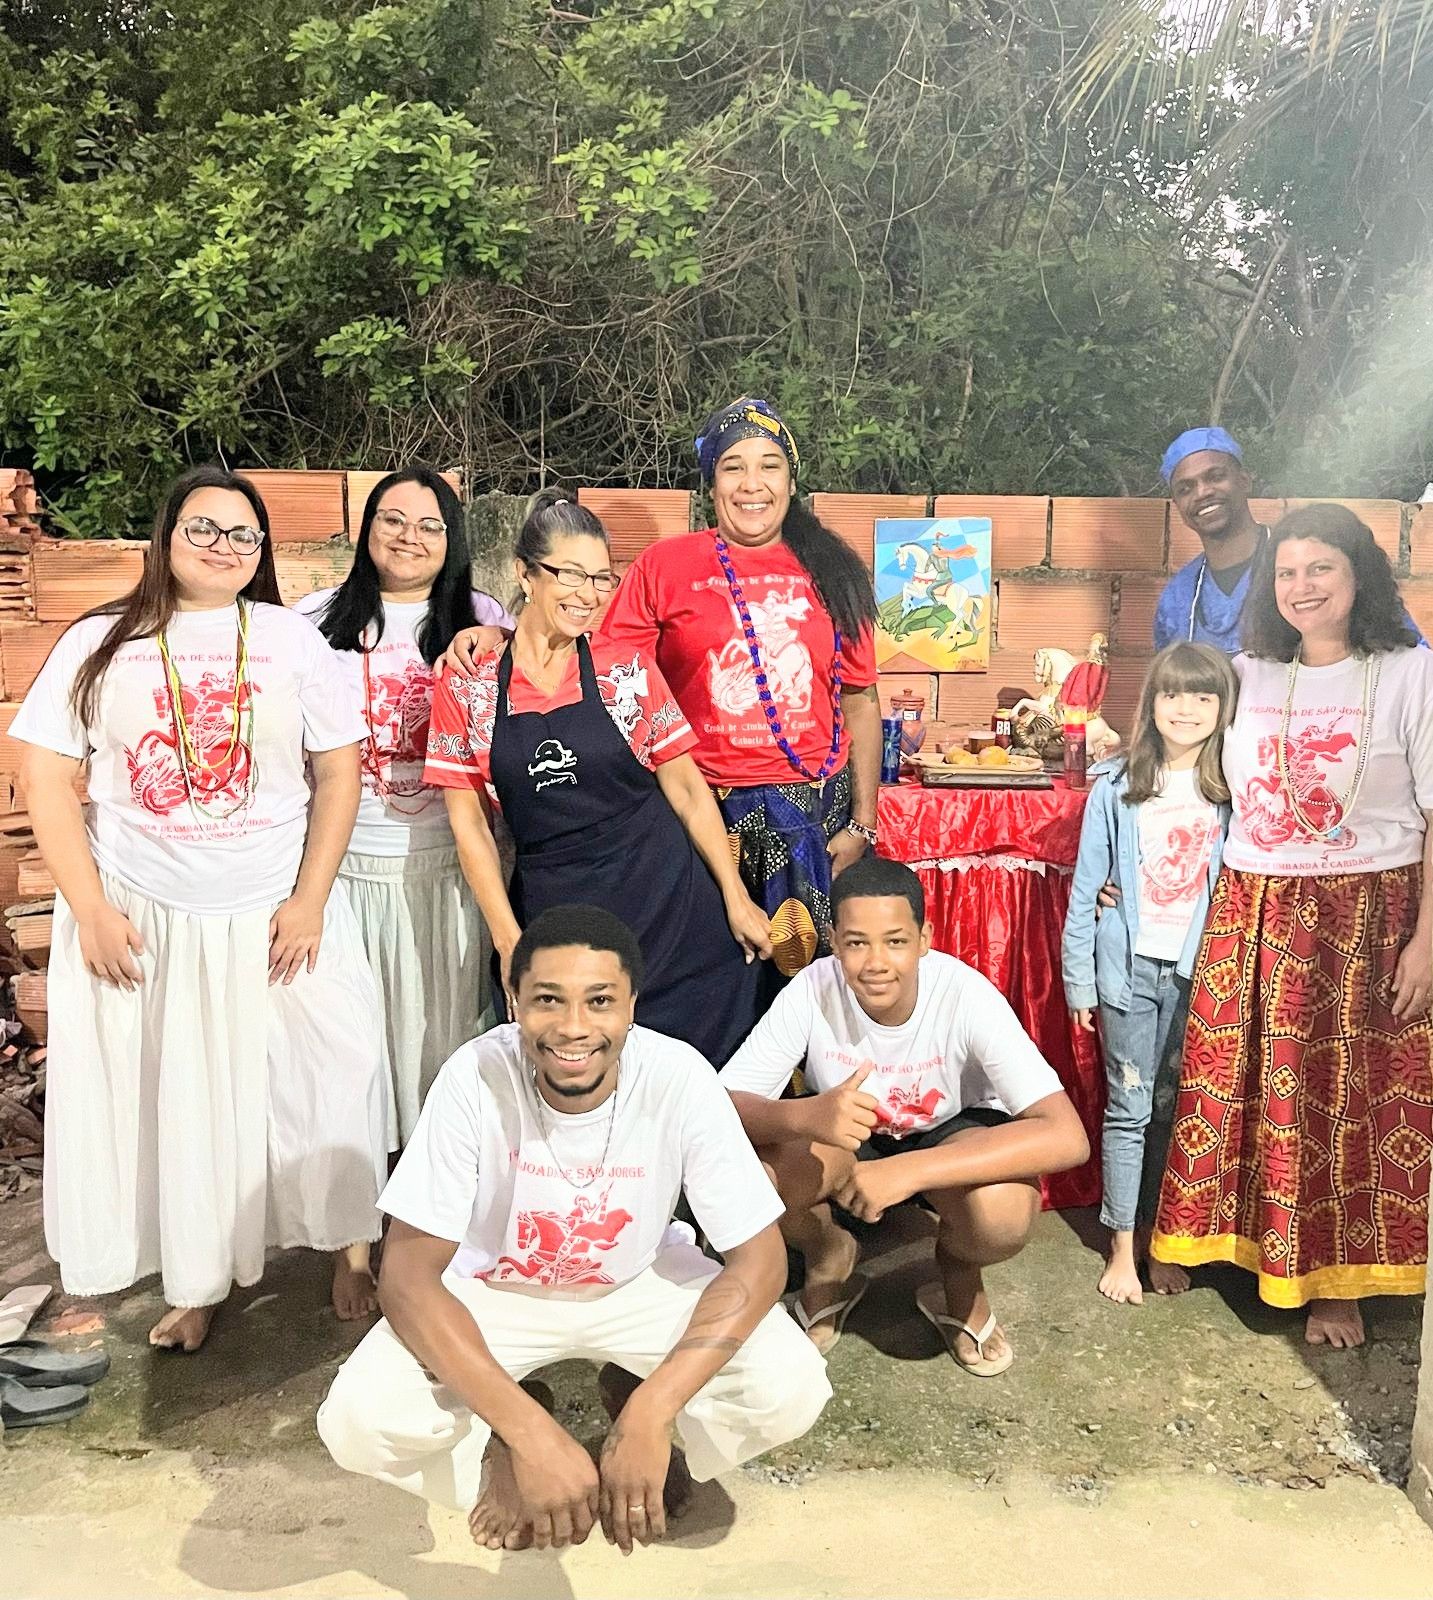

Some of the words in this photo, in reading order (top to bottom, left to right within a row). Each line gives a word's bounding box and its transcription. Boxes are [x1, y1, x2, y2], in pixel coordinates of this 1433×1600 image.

[190, 654, 206, 662] DE
[1300, 708, 1314, 716] DE
[1321, 860, 1328, 869] E
[1330, 856, 1376, 869] CARIDADE
[882, 1065, 895, 1074] DE
[608, 1166, 646, 1179] JORGE
